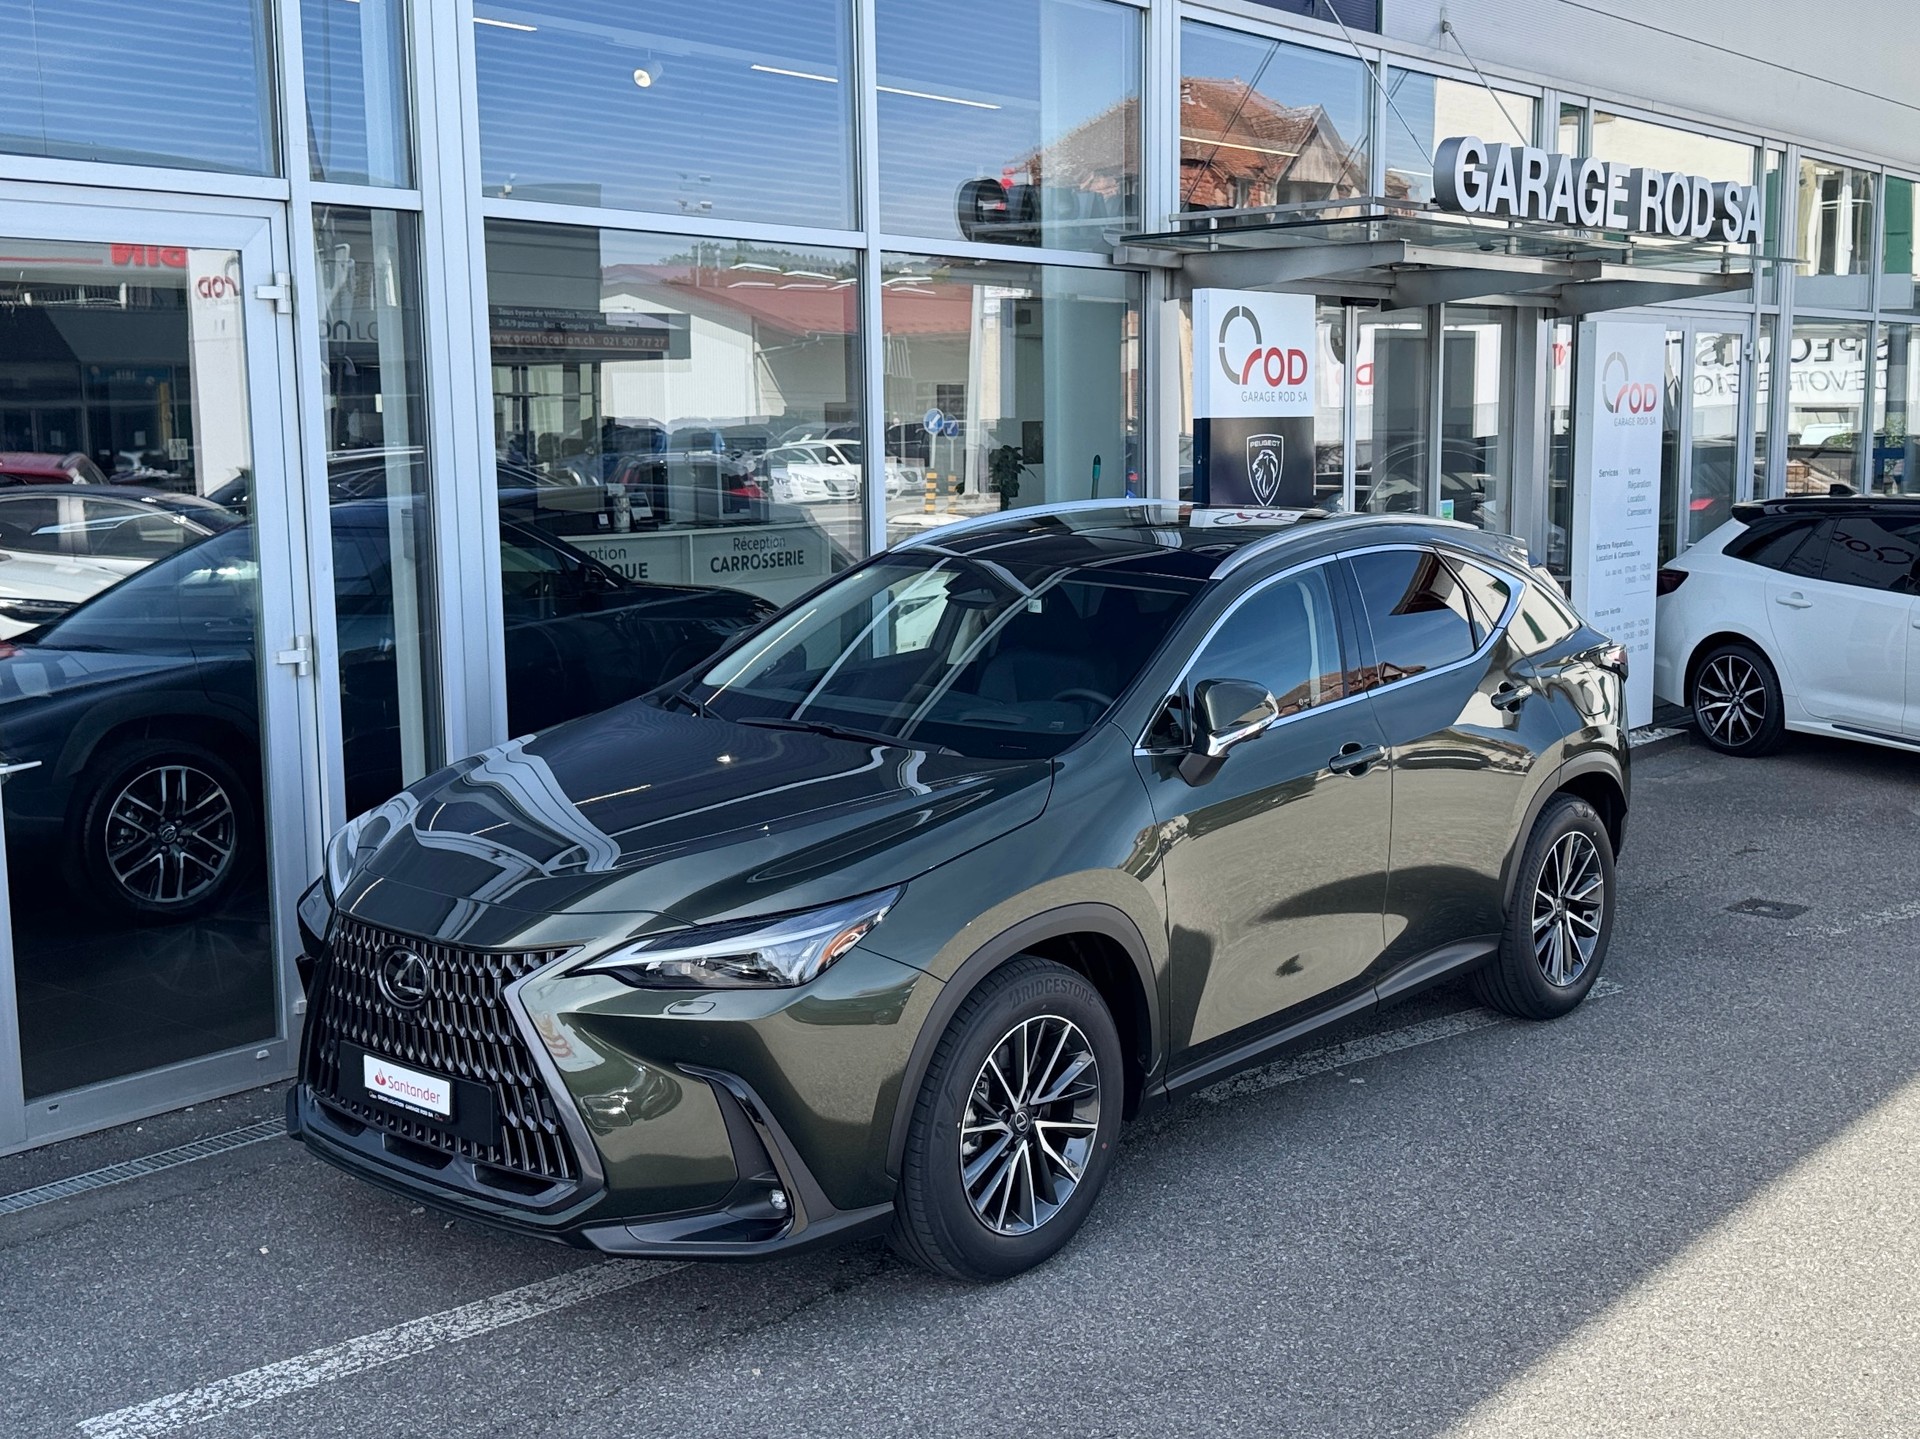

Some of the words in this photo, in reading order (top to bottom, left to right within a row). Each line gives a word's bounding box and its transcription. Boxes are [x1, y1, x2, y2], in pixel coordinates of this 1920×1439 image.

[1436, 135, 1630, 230] GARAGE
[1636, 167, 1714, 238] ROD
[1720, 180, 1762, 244] SA
[1241, 391, 1276, 403] GARAGE
[1278, 391, 1296, 402] ROD
[1298, 391, 1308, 402] SA
[1613, 417, 1636, 427] GARAGE
[733, 536, 786, 554] Réception
[710, 550, 804, 574] CARROSSERIE
[1008, 978, 1095, 1009] BRIDGESTONE
[388, 1075, 440, 1104] Santander
